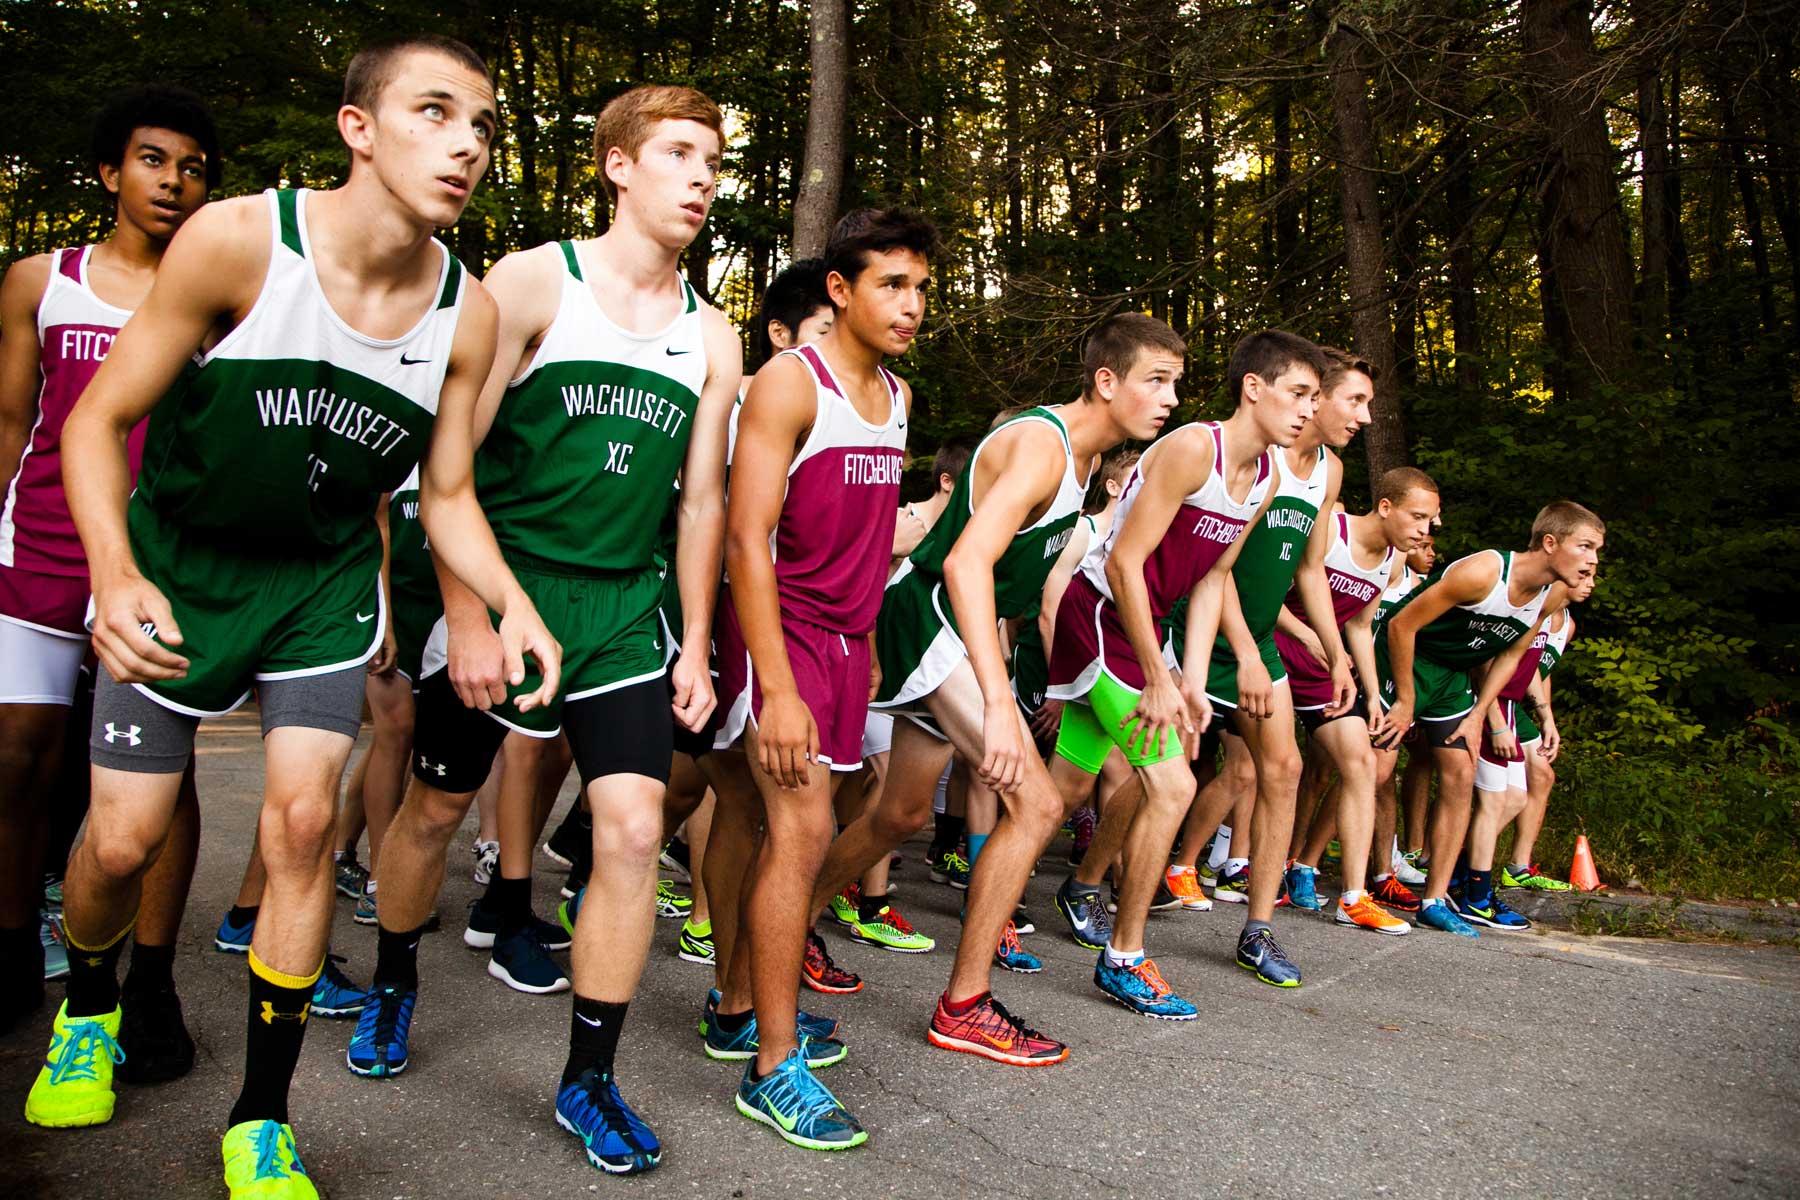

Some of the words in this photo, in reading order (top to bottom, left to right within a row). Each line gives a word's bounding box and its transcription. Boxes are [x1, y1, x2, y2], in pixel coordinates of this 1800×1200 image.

[256, 387, 410, 456] WACHUSETT
[561, 384, 687, 439] WACHUSETT
[604, 441, 634, 475] XC
[1266, 508, 1314, 537] WACHUSETT
[1279, 542, 1293, 561] XC
[1467, 636, 1487, 649] XC
